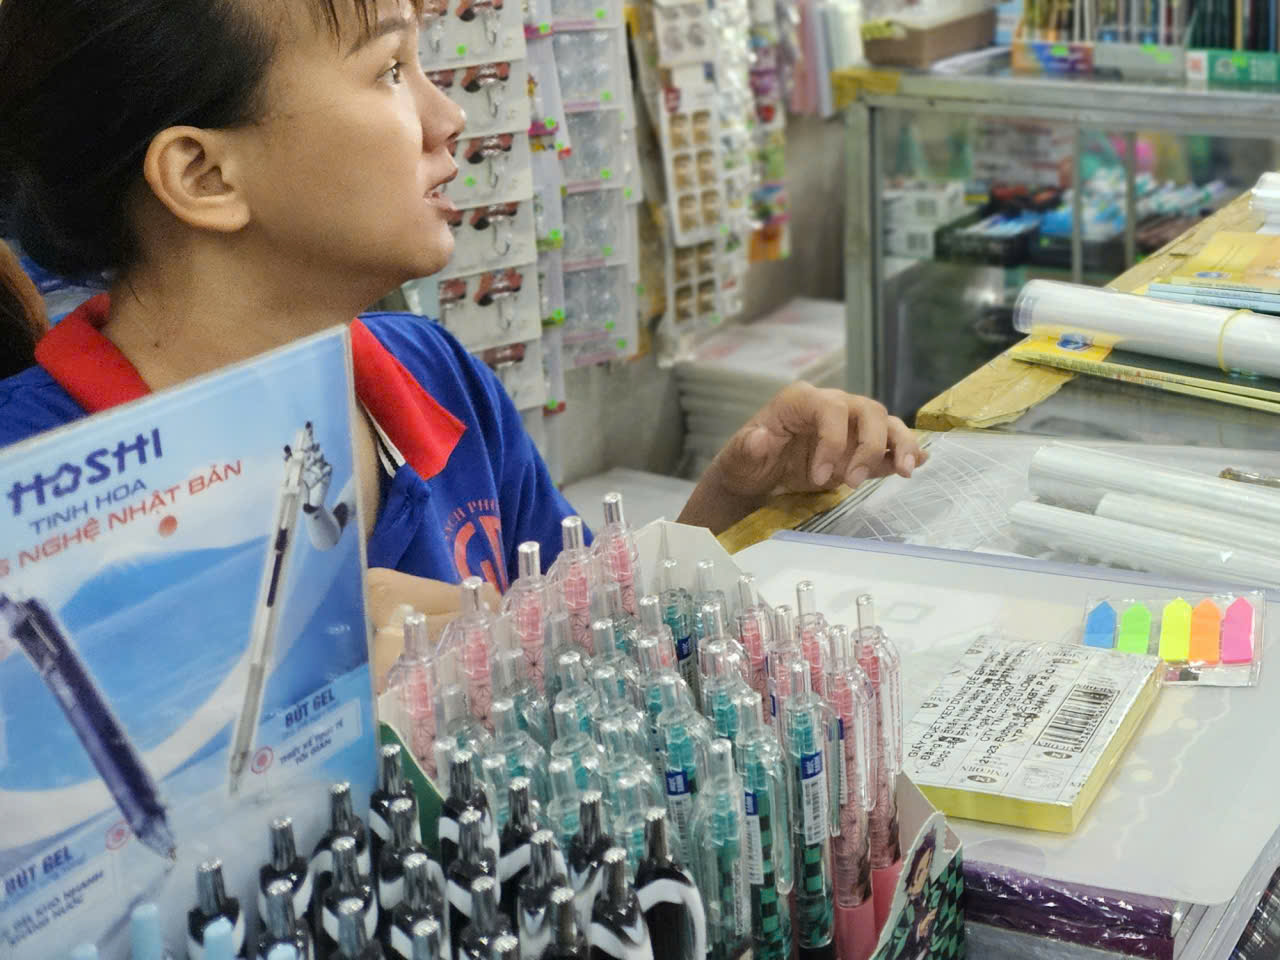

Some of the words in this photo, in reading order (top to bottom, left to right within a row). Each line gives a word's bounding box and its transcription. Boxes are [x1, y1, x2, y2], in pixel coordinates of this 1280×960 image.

[8, 427, 163, 517] HOSHI
[29, 500, 89, 535] TINH
[96, 478, 147, 511] HOA
